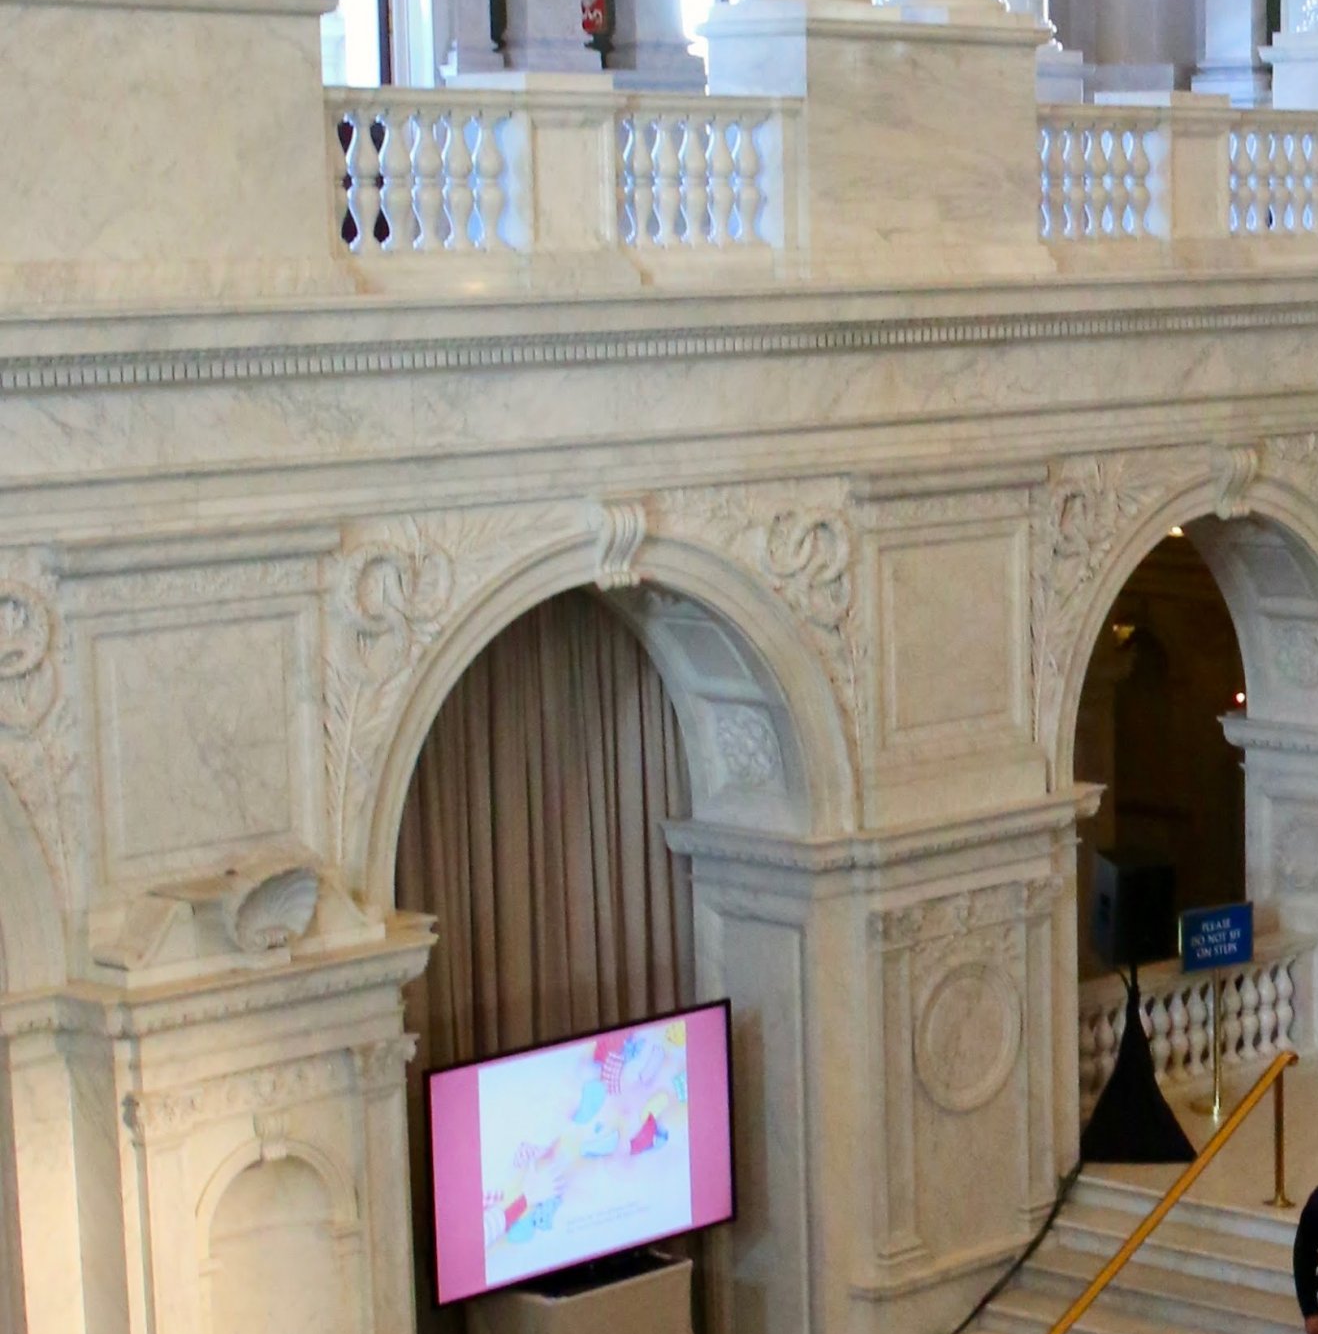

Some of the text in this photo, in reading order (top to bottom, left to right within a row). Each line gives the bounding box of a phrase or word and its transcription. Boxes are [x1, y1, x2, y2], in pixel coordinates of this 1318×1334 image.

[1202, 918, 1231, 932] PLEASE
[1191, 928, 1241, 948] DO NOT SIT
[1196, 942, 1237, 958] ON STEPS
